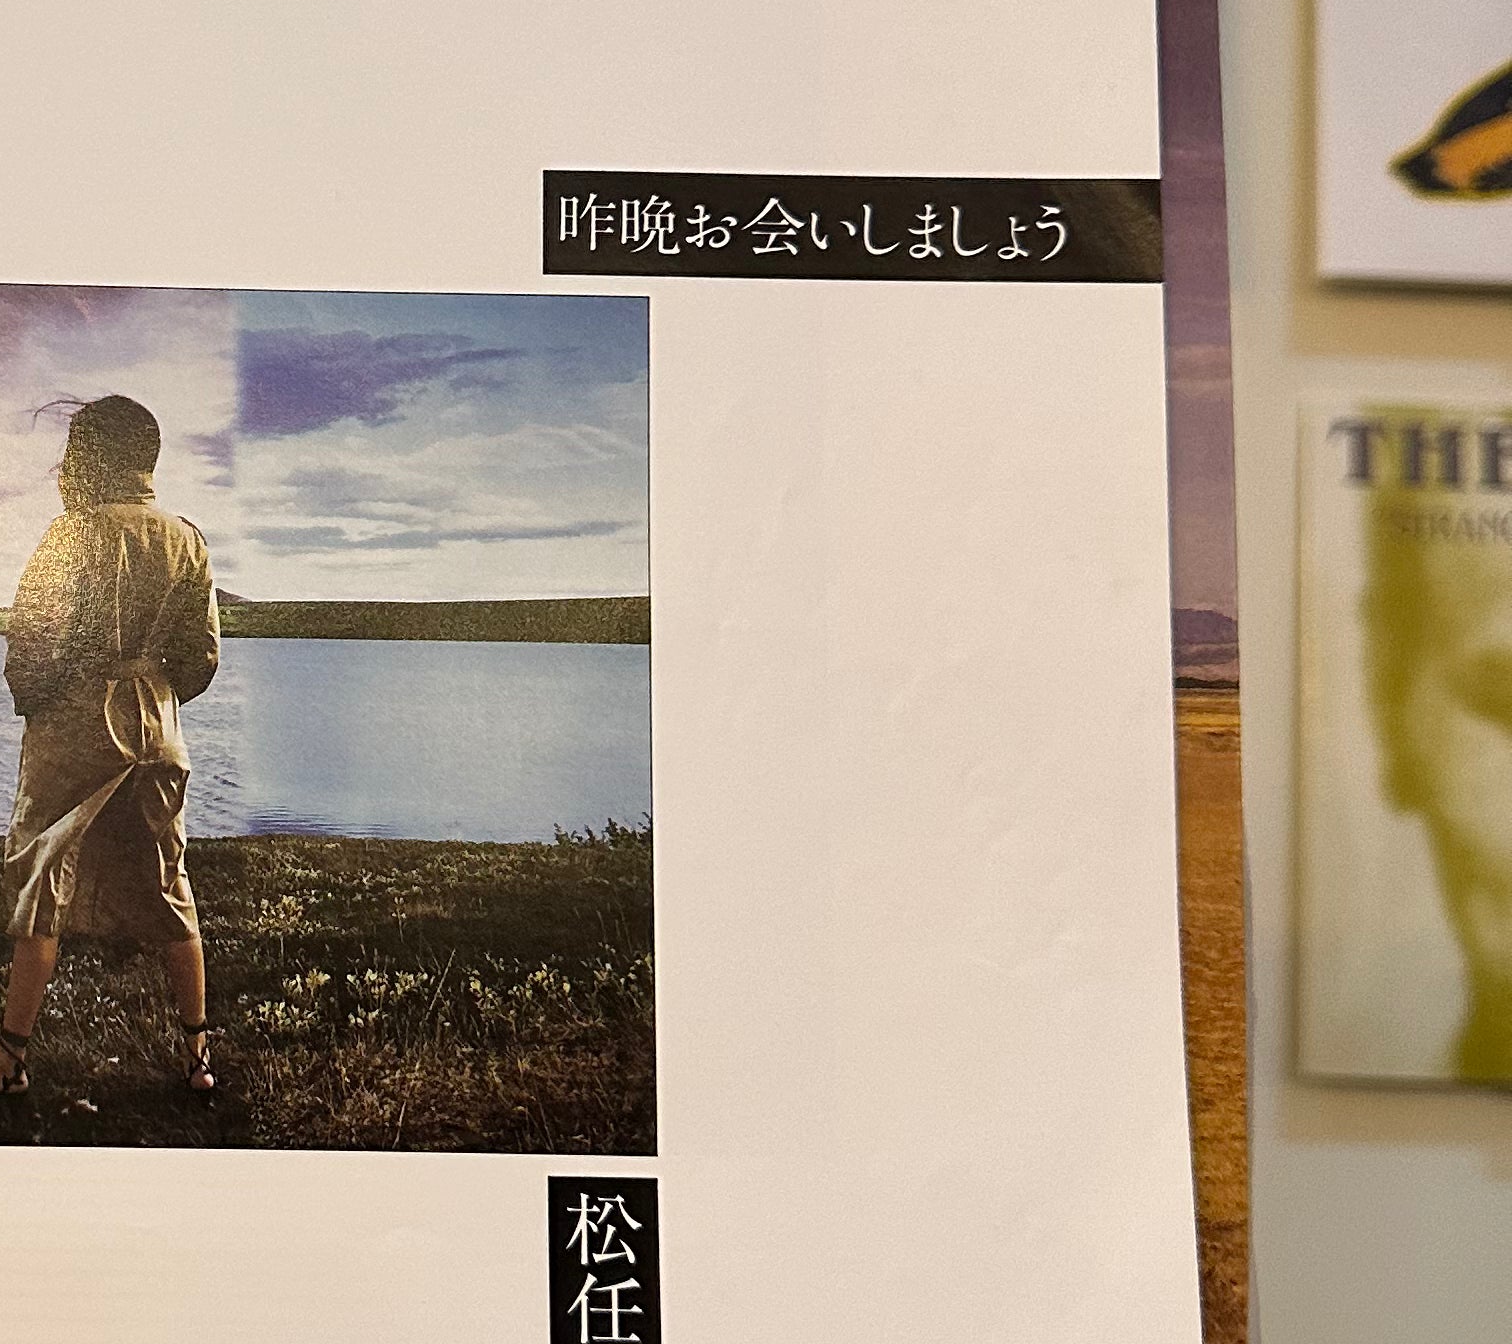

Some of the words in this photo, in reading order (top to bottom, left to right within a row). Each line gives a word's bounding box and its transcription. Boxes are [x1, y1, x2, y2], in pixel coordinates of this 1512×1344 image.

[558, 192, 1070, 261] 昨晩お会いしましょう
